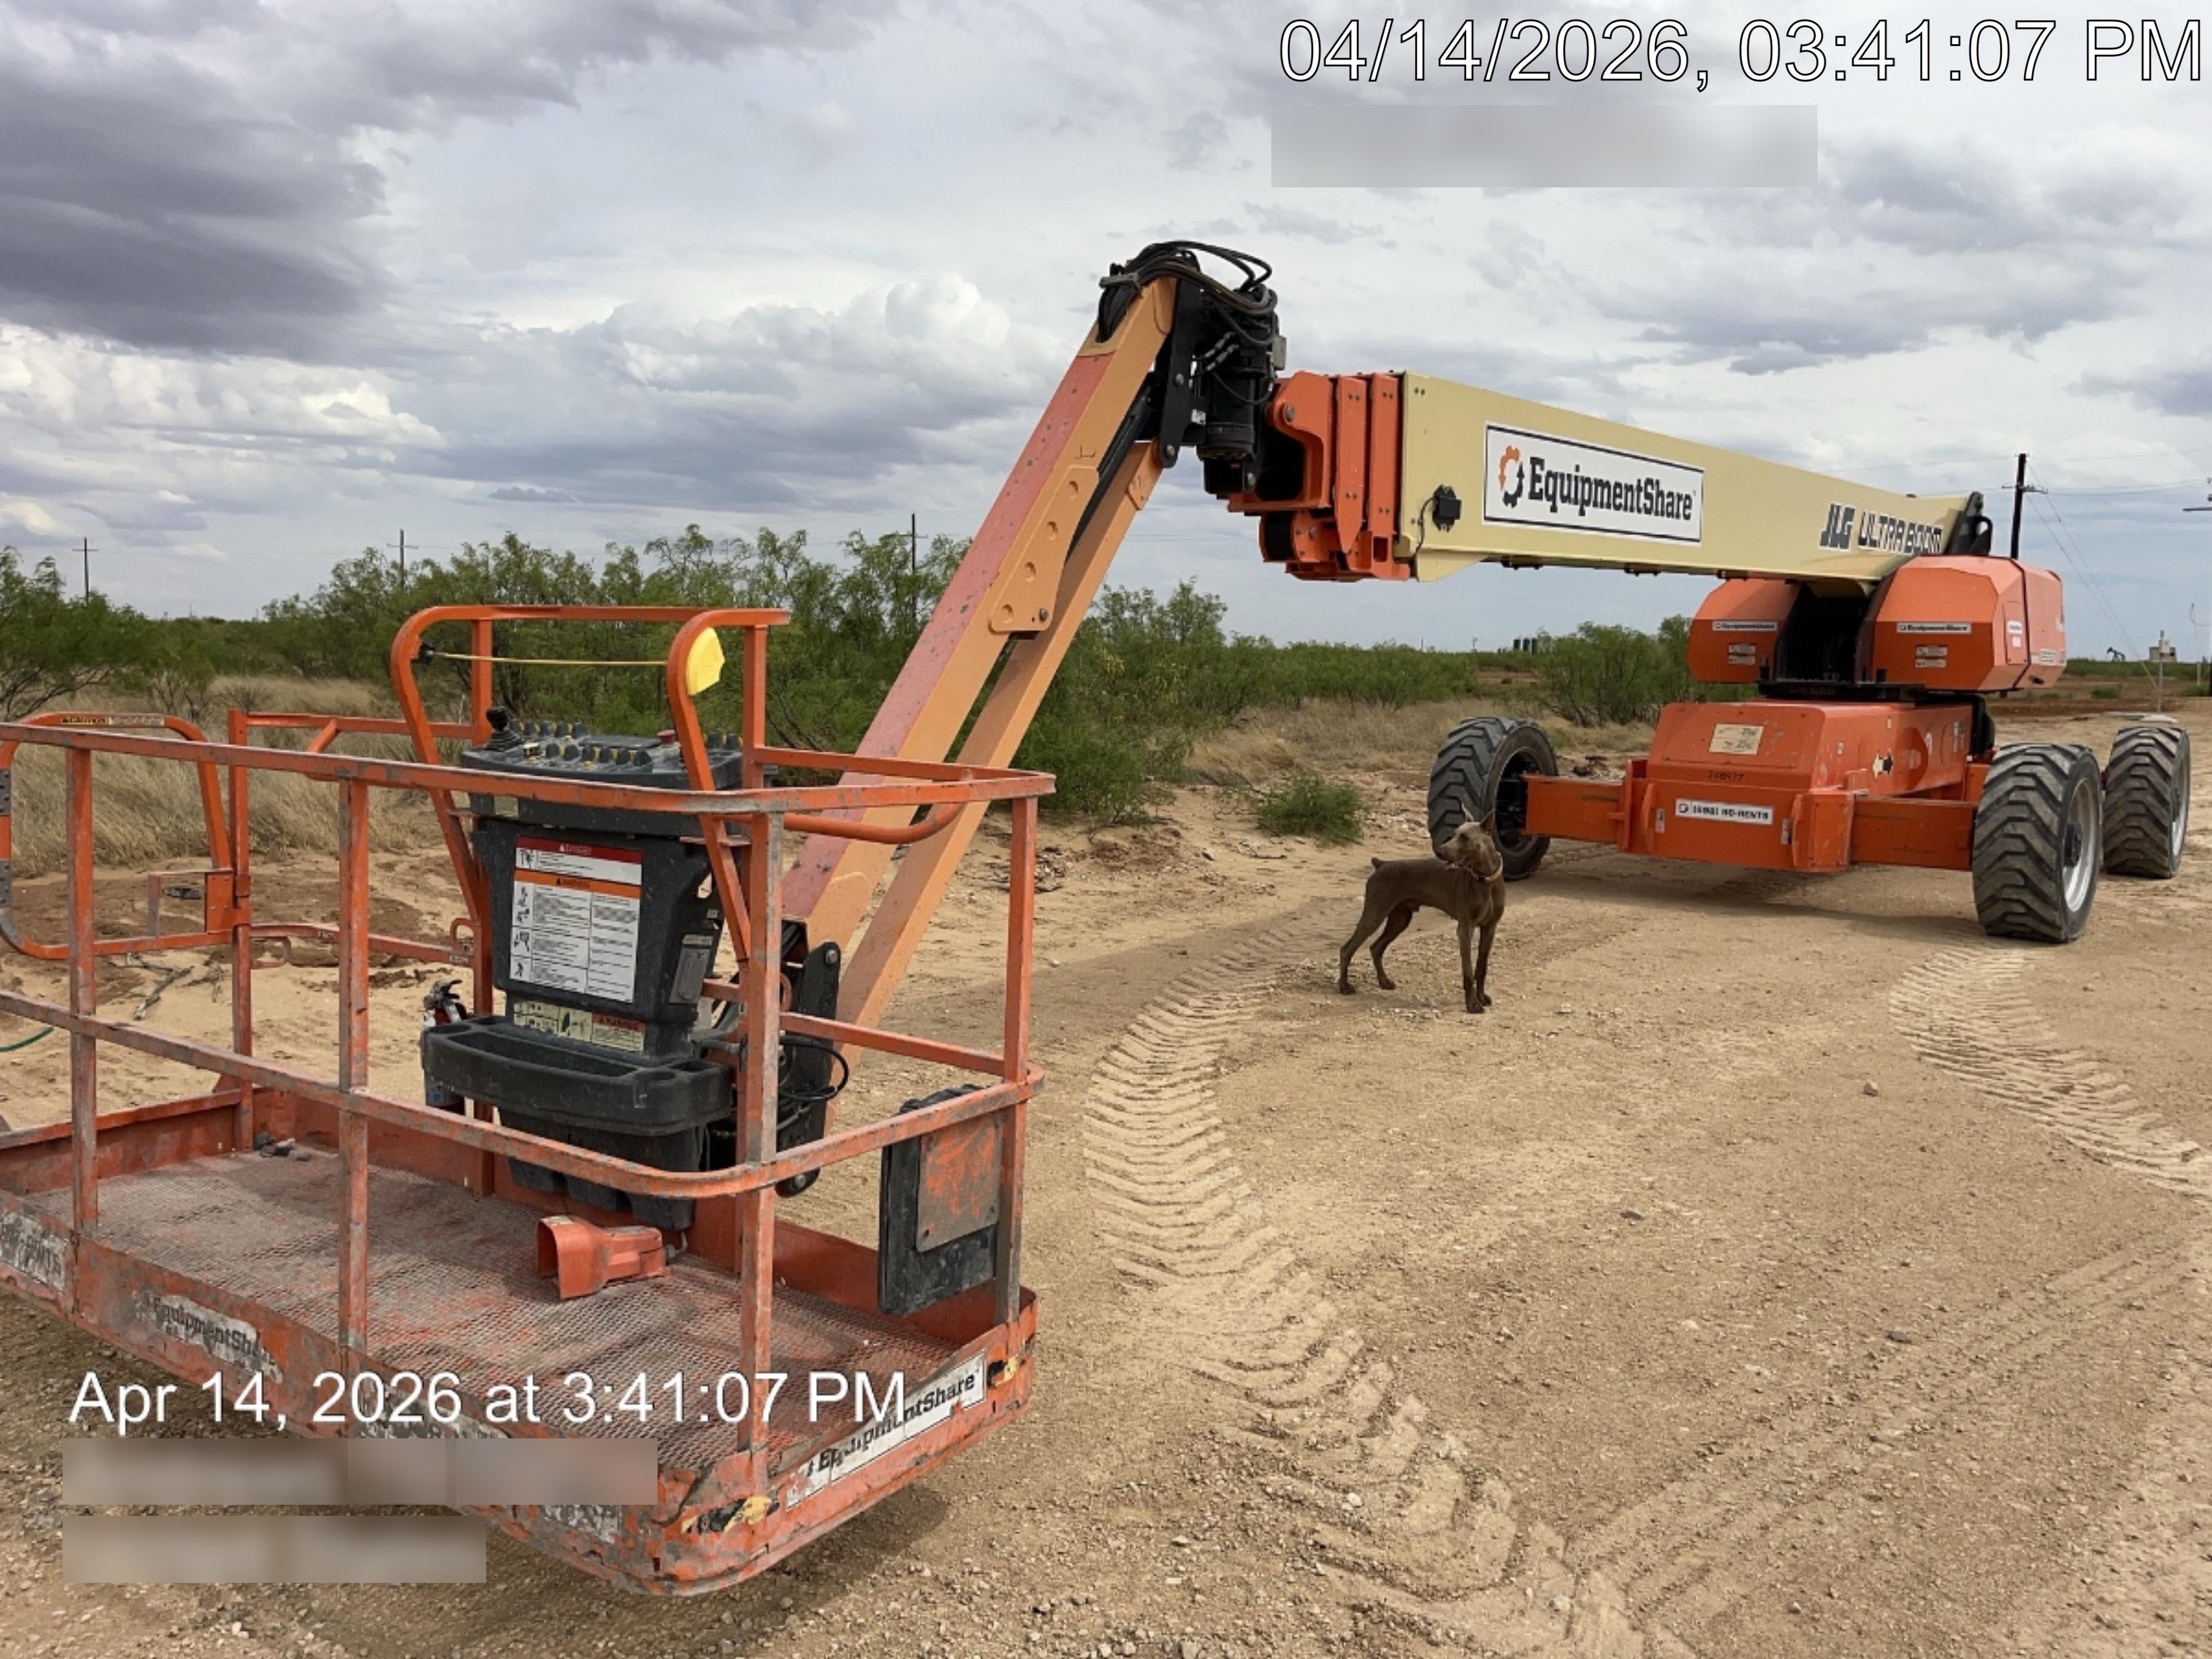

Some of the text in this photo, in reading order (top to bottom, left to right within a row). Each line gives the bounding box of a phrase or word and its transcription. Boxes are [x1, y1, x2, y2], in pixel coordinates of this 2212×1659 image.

[1528, 457, 1693, 521] EquipmentShare
[1819, 502, 1943, 554] JLG ULTRA BOOM
